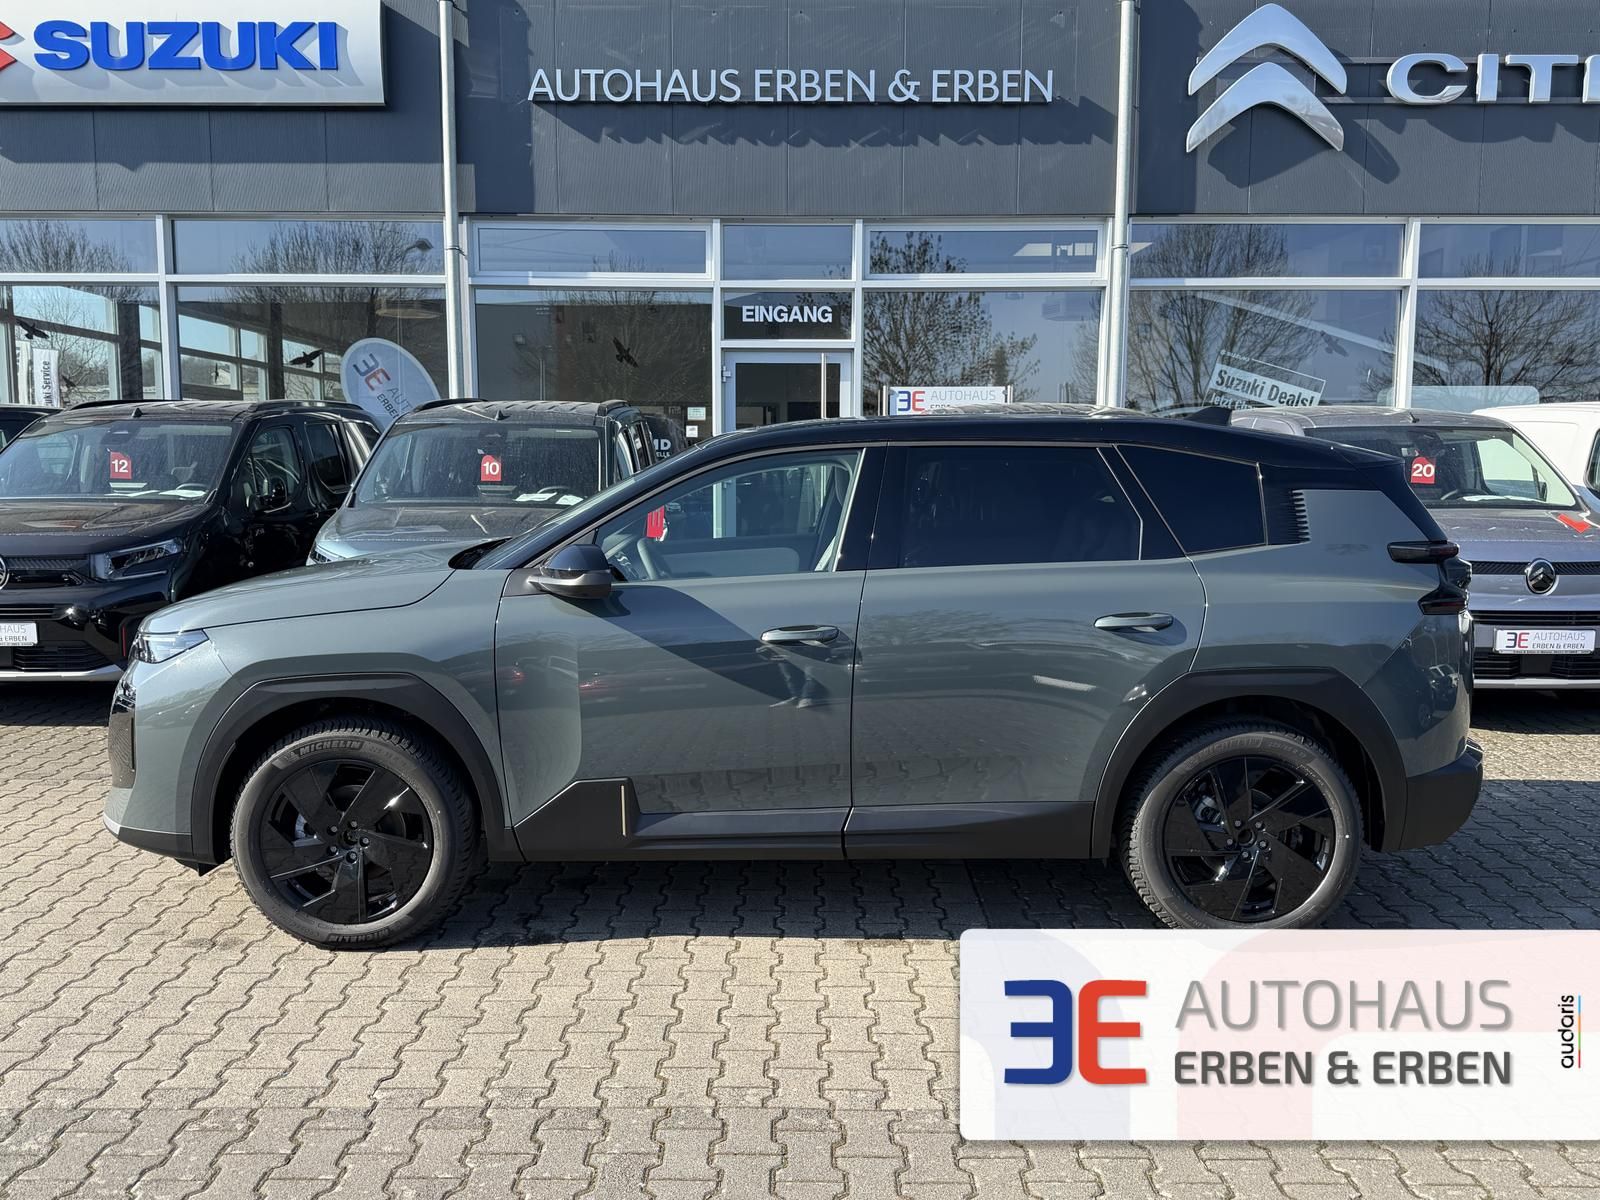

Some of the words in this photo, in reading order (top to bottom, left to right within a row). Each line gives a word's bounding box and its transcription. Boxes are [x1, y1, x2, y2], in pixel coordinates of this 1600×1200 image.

[33, 20, 339, 71] SUZUKI
[528, 68, 741, 103] AUTOHAUS
[754, 69, 876, 103] ERBEN
[887, 69, 921, 103] &
[931, 69, 1054, 103] ERBEN
[741, 305, 833, 324] EINGANG
[42, 360, 50, 390] Service
[1215, 369, 1266, 398] Suzuki
[930, 390, 996, 401] AUTOHAUS
[111, 459, 129, 473] 12
[483, 461, 500, 475] 10
[1411, 463, 1435, 477] 20
[1534, 632, 1586, 641] AUTOHAUS
[300, 740, 361, 755] MICHELIN
